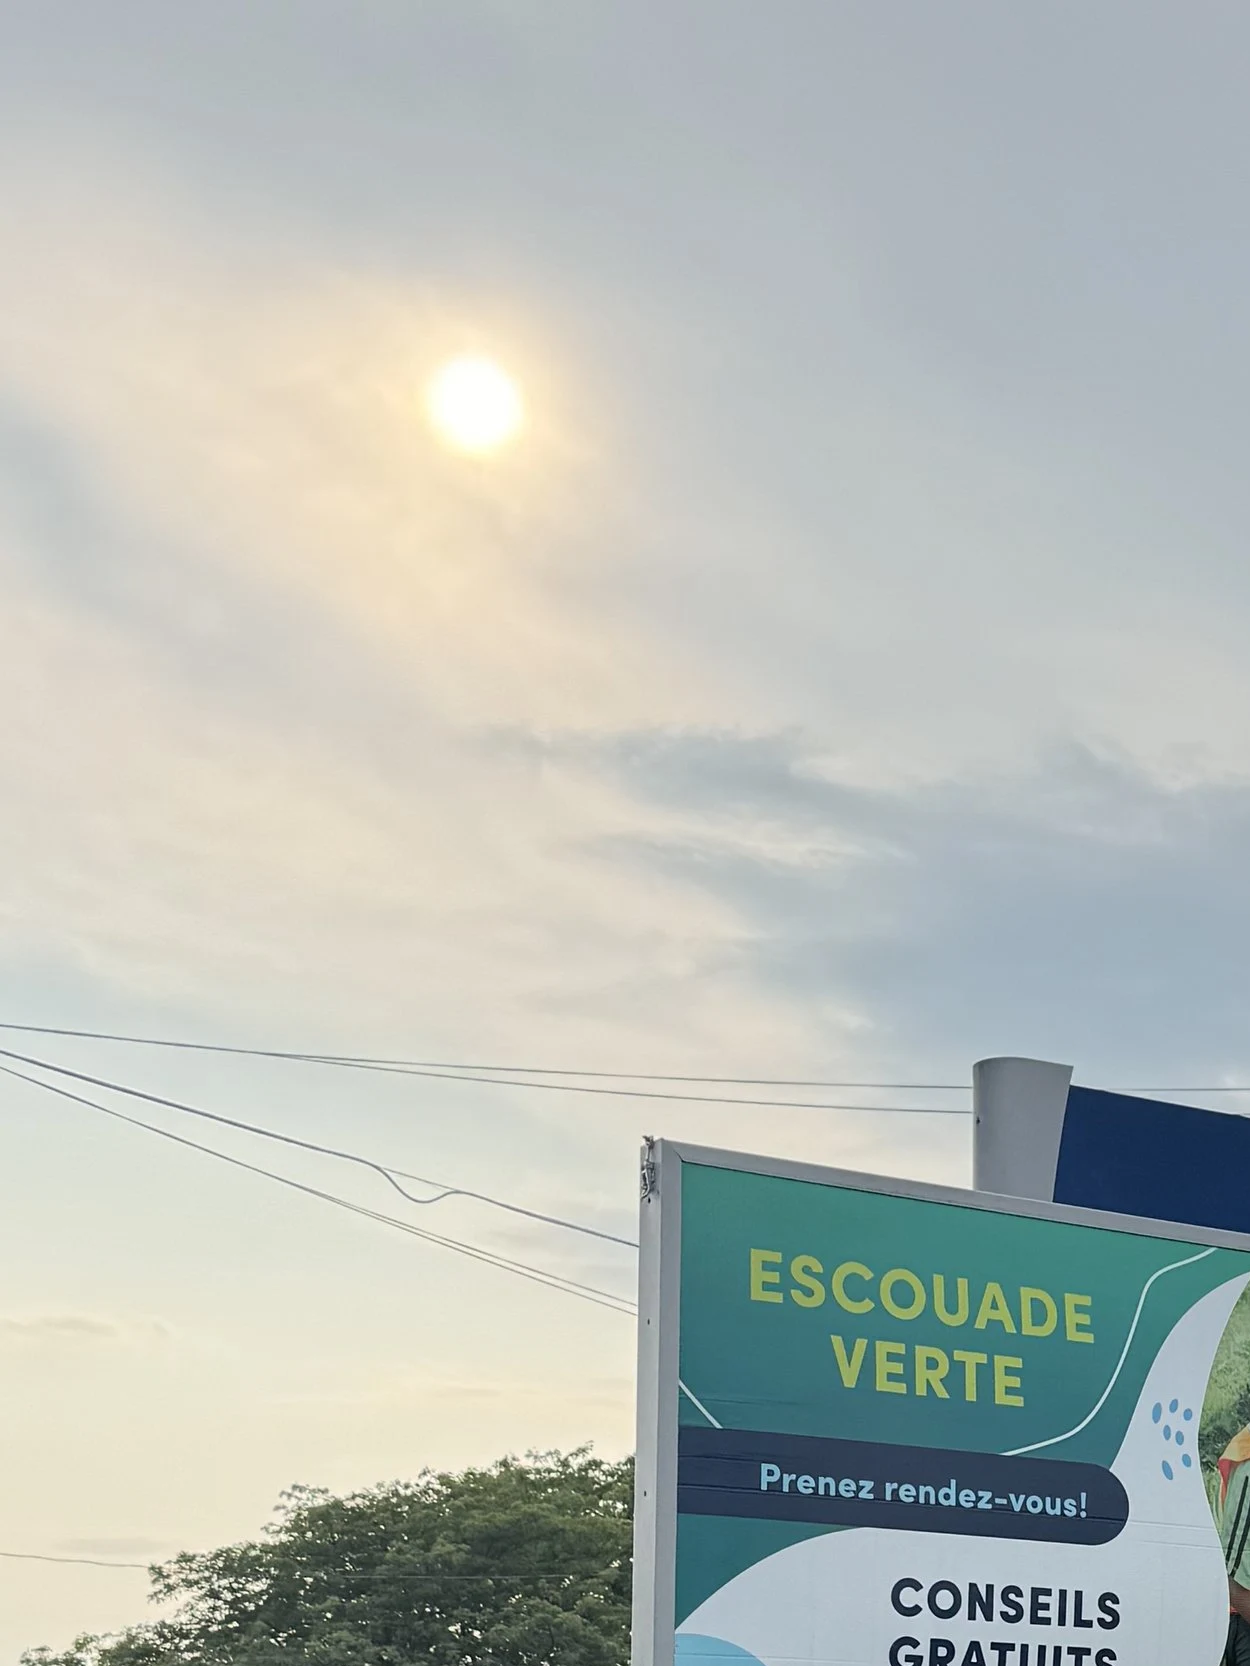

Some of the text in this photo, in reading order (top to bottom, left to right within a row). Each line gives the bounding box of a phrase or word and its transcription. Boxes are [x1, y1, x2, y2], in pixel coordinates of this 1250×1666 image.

[749, 1248, 1095, 1344] ESCOUADE
[830, 1335, 1026, 1408] VERTE
[759, 1462, 1088, 1520] Prenez rendez-vous!
[890, 1577, 1121, 1630] CONSEILS
